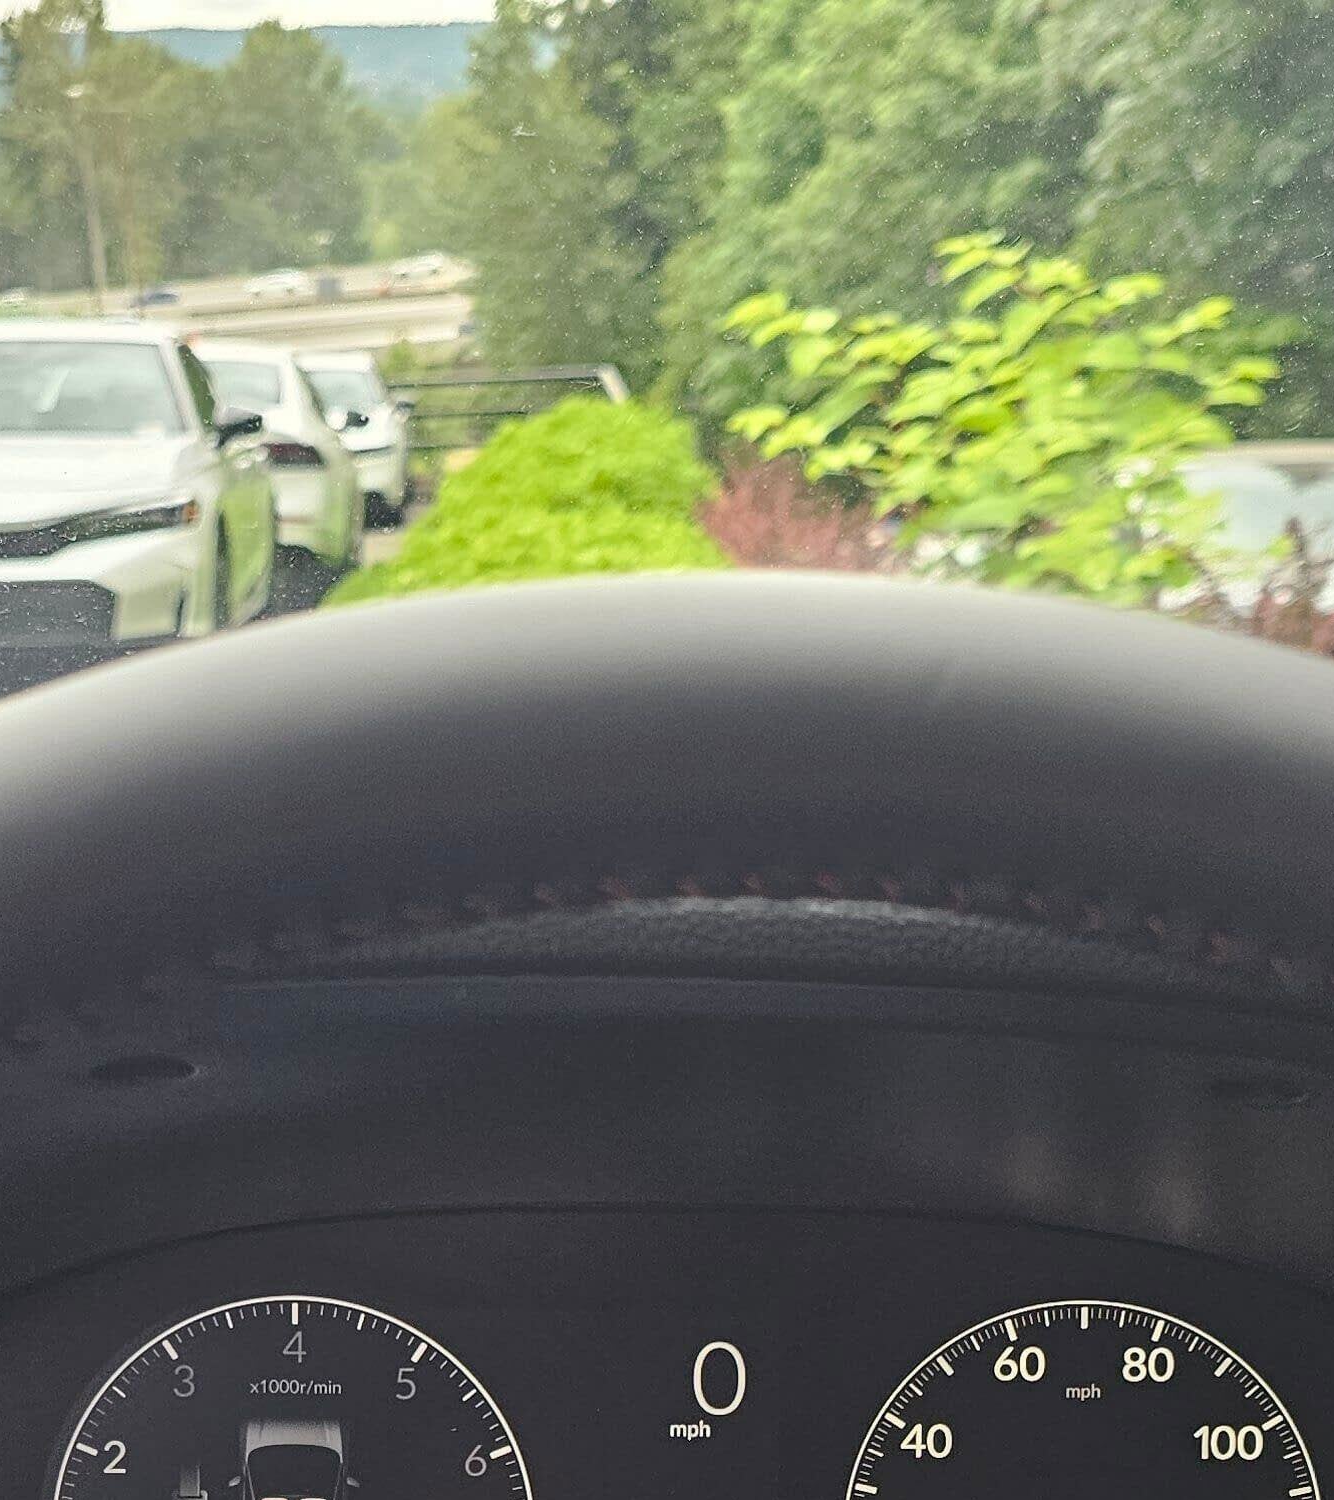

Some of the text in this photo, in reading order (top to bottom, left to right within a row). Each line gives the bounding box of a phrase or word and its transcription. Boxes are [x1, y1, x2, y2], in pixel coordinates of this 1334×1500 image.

[282, 1330, 307, 1364] 4
[993, 1346, 1046, 1382] 60
[173, 1364, 195, 1398] 3
[693, 1341, 746, 1416] 0
[1121, 1346, 1175, 1383] 80
[249, 1379, 342, 1396] x1000r/min
[395, 1367, 417, 1401] 5
[1065, 1384, 1101, 1400] mph
[669, 1420, 711, 1441] mph
[900, 1424, 953, 1459] 40
[1193, 1425, 1264, 1461] 100
[103, 1440, 127, 1474] 2
[464, 1444, 487, 1477] 6
